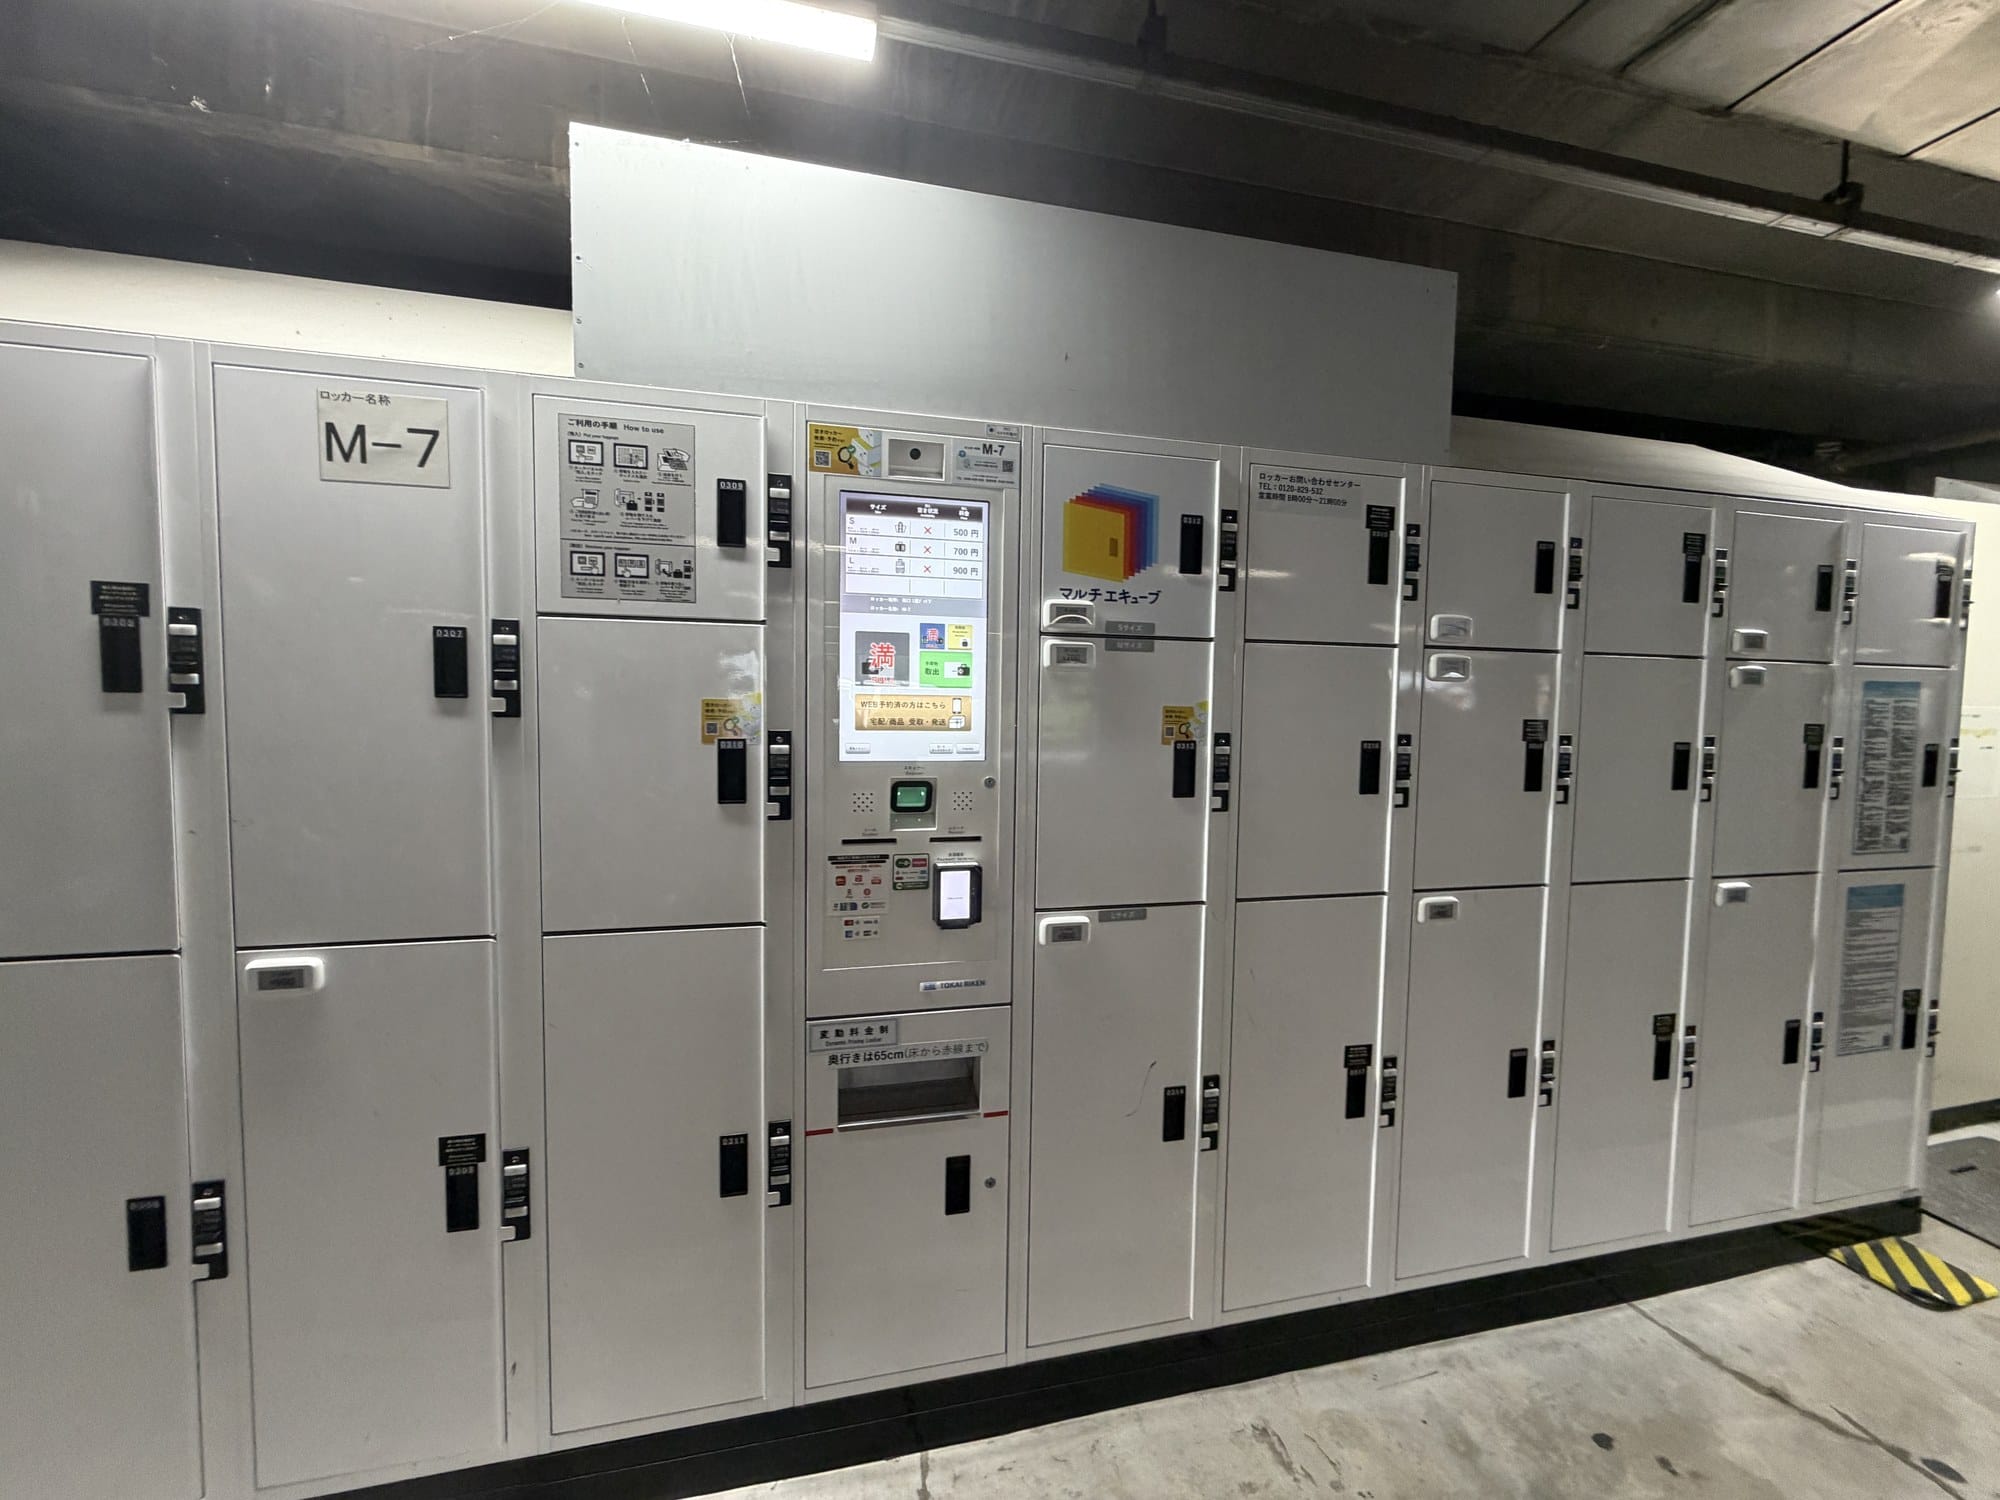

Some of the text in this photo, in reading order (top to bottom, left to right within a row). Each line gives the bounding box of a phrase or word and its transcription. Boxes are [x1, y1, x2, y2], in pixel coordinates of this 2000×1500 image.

[320, 390, 391, 406] ロッカー名称
[568, 418, 618, 430] ご利用の手順
[623, 424, 639, 433] How
[325, 421, 440, 468] M-7
[982, 443, 1005, 456] M-7
[1259, 473, 1361, 488] ロッカーお問い合わせセンター
[849, 517, 855, 525] S
[953, 528, 979, 538] 500 円
[849, 537, 857, 545] M
[953, 547, 979, 557] 700 円
[849, 556, 855, 564] L
[952, 566, 979, 576] 900 円
[1059, 587, 1163, 604] マルチエキューブ
[870, 642, 896, 668] 満
